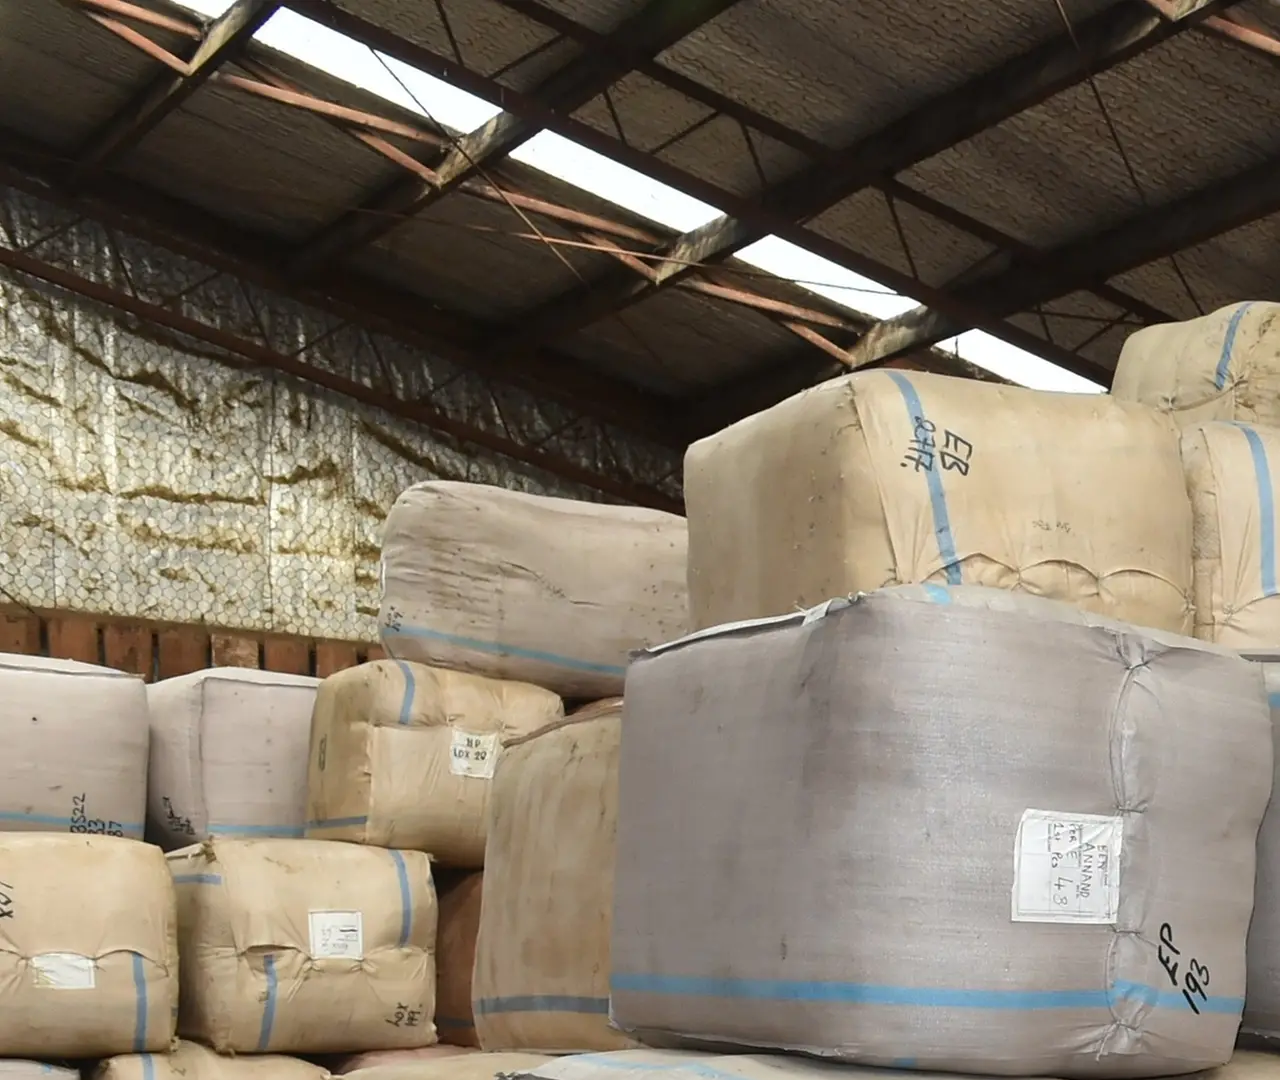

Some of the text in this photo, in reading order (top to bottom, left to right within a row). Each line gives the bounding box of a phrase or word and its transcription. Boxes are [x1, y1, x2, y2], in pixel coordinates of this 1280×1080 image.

[939, 429, 973, 476] EB
[1079, 842, 1096, 899] ANNAND
[1158, 922, 1181, 986] EP
[1182, 958, 1210, 1015] 193
